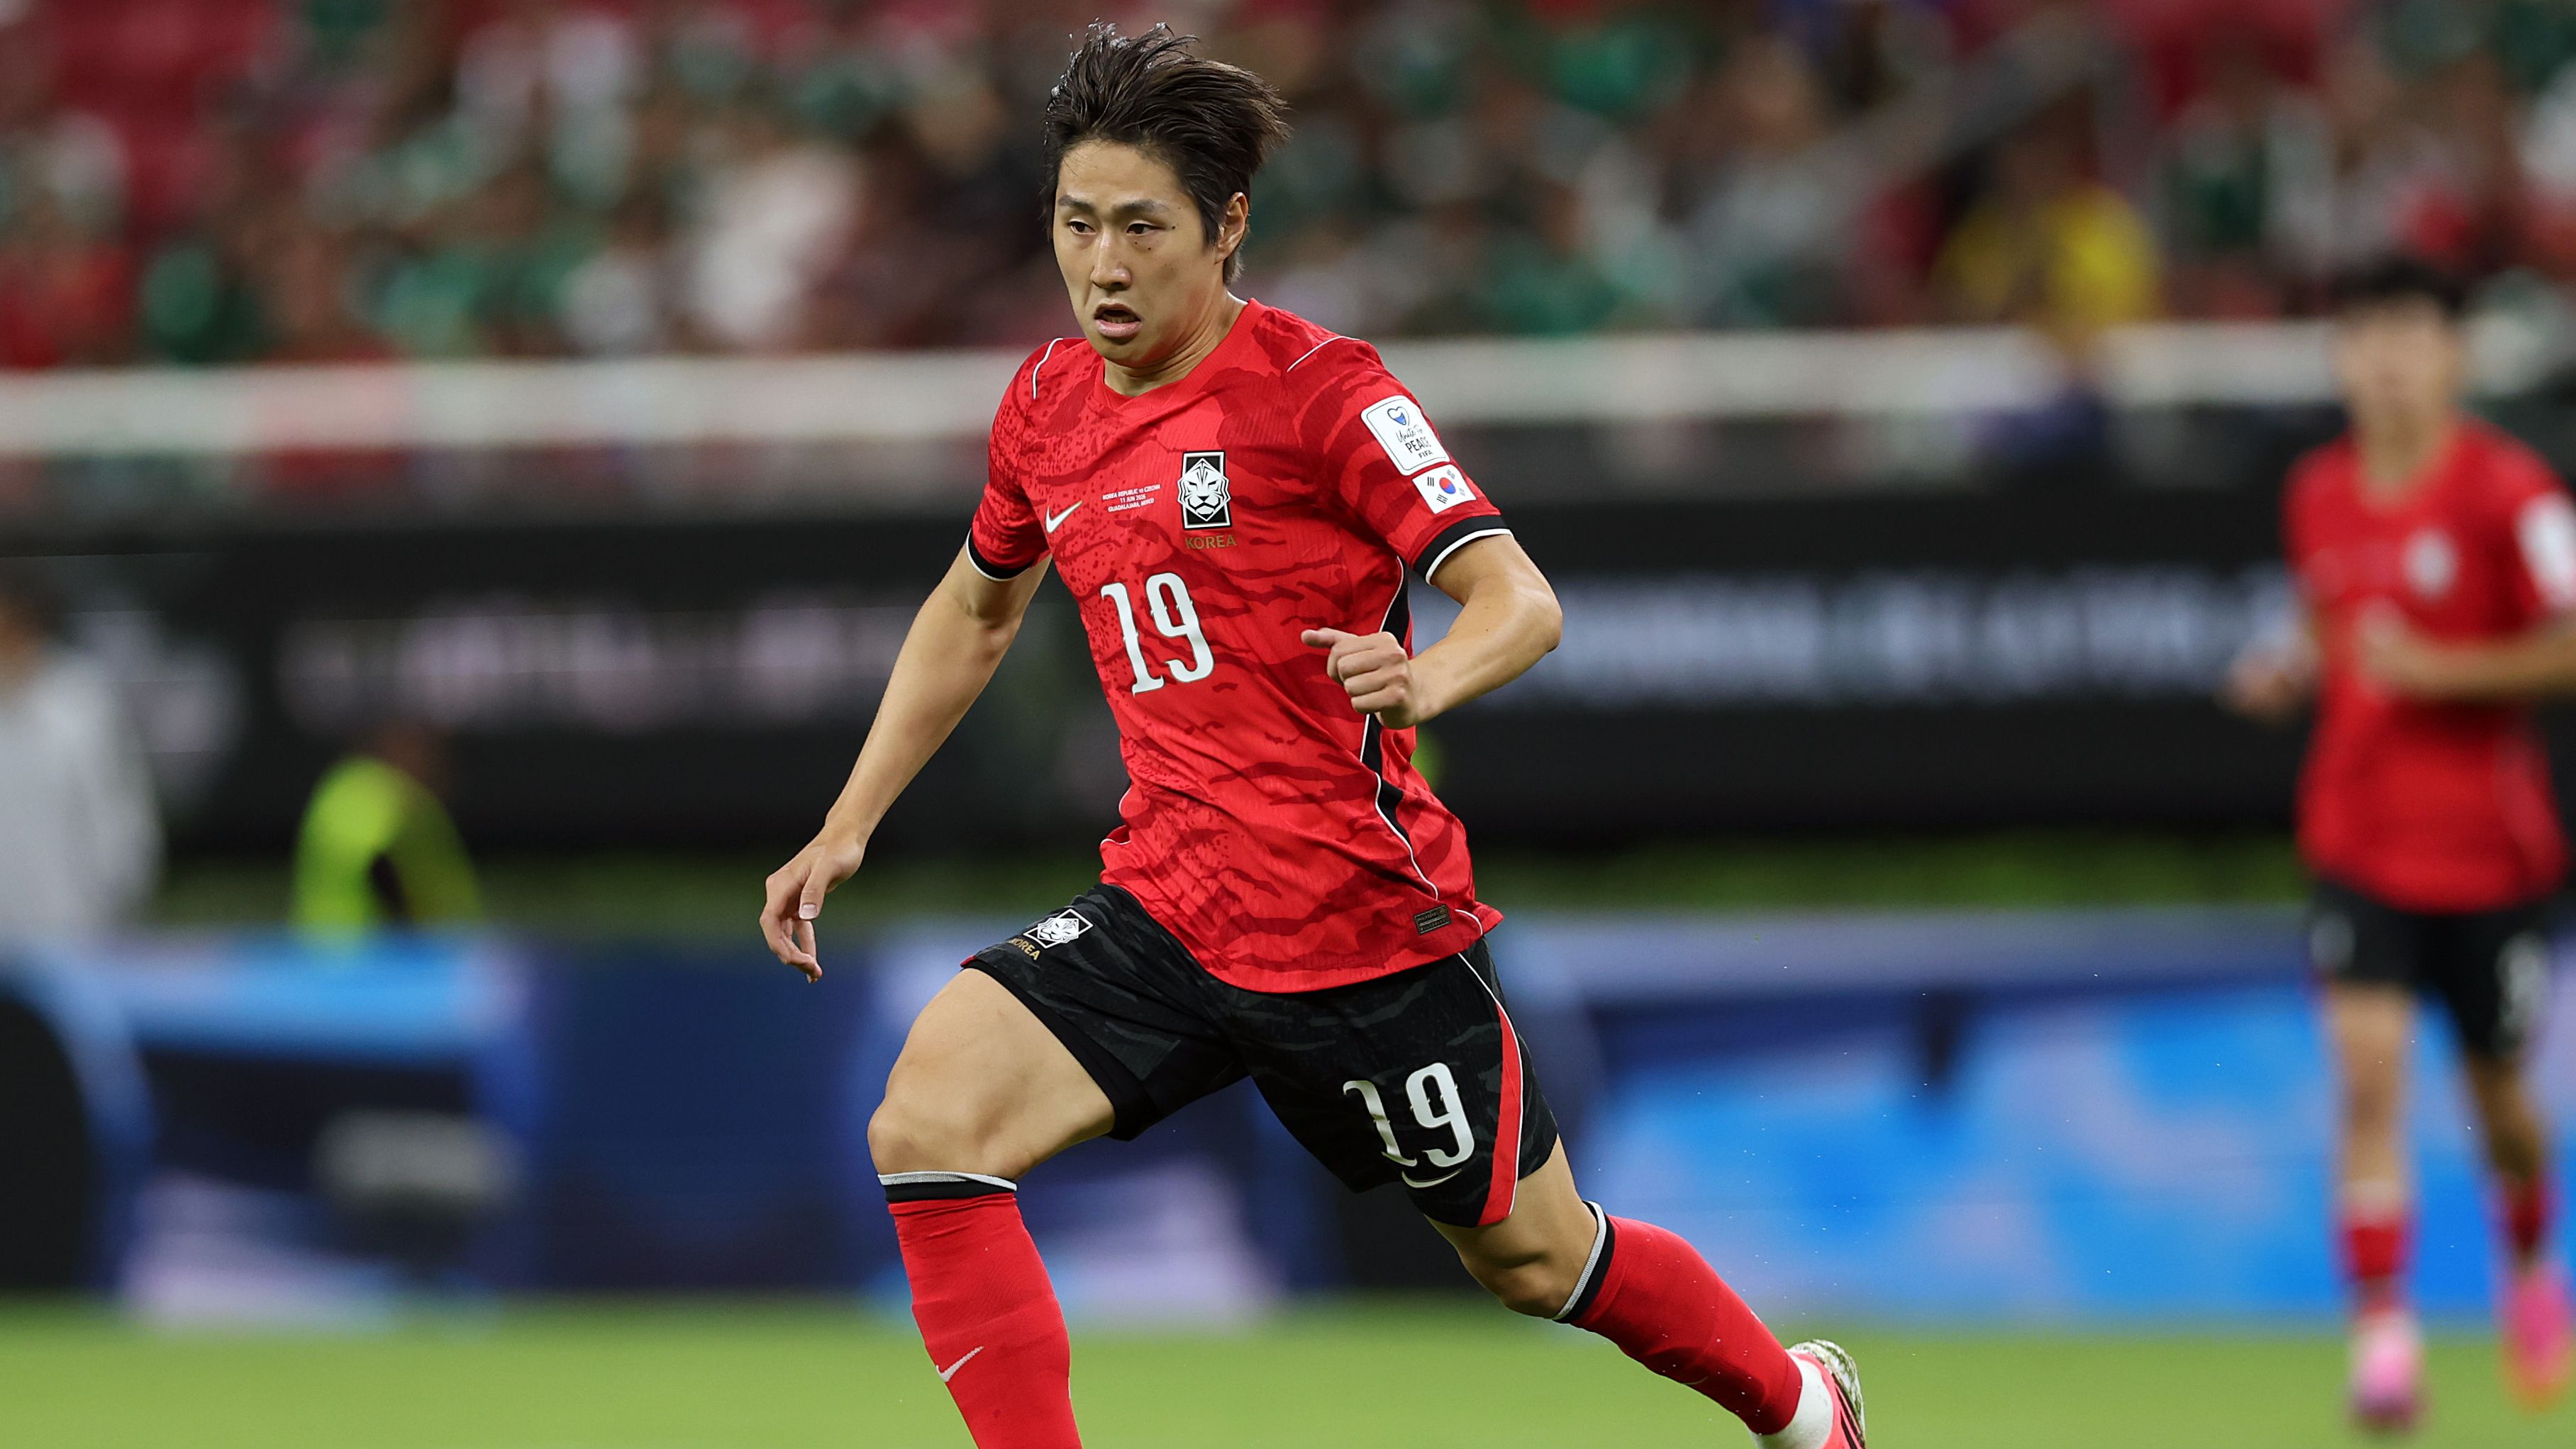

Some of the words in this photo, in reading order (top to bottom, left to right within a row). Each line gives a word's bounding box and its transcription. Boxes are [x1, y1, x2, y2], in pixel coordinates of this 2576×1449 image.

[1405, 437, 1431, 453] PEACE
[1419, 450, 1433, 459] FIFA
[1185, 534, 1238, 550] KOREA
[1101, 572, 1214, 698] 19
[1343, 1062, 1475, 1167] 19
